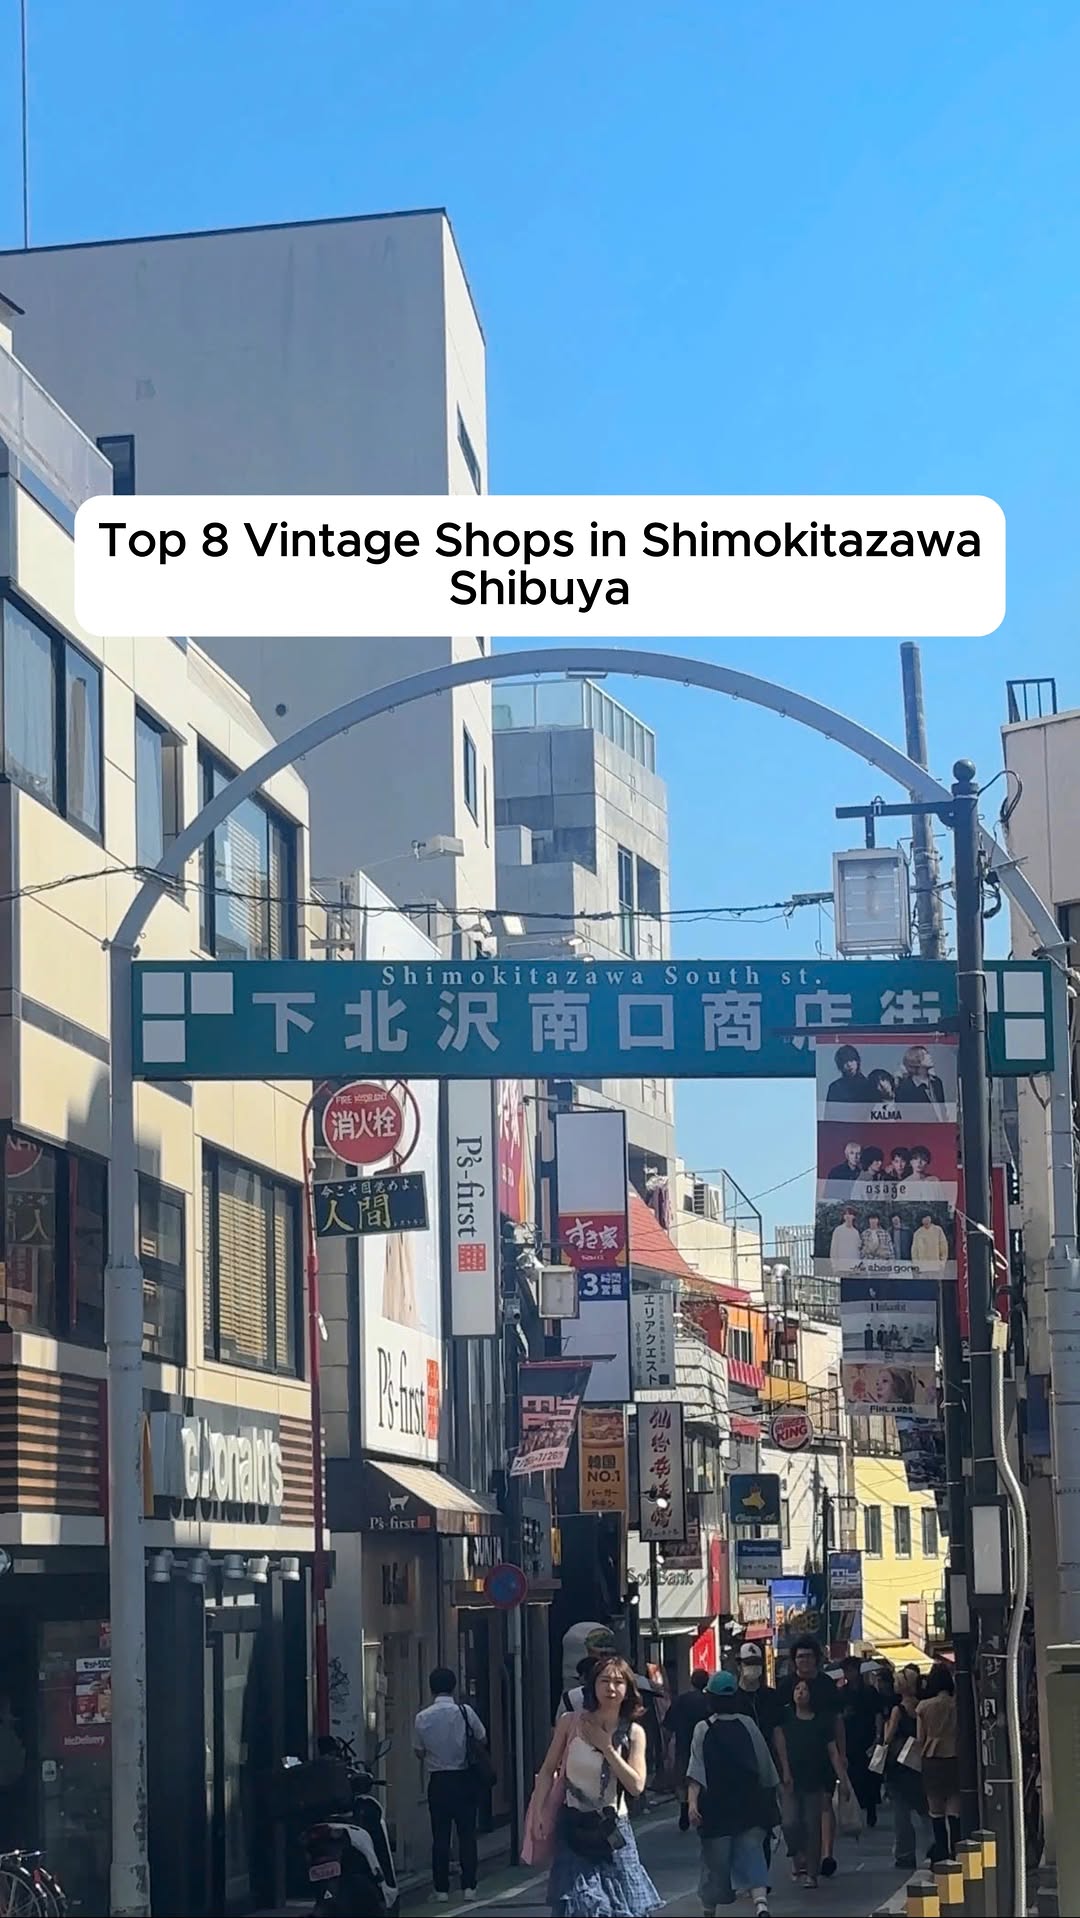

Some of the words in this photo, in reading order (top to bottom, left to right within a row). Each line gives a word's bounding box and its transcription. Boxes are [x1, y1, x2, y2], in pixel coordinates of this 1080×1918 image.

[382, 966, 644, 986] Shimokitazawa
[665, 966, 759, 985] South
[782, 968, 822, 985] st.
[252, 989, 942, 1053] 下北沢南口商店街
[331, 1107, 397, 1142] 消火栓
[870, 1110, 902, 1121] KALMA
[866, 1183, 907, 1199] osage
[321, 1193, 391, 1232] 人間
[565, 1217, 619, 1250] すき家
[644, 1294, 657, 1386] エリアクエスト
[777, 1426, 808, 1444] KING
[587, 1470, 621, 1482] NO.1
